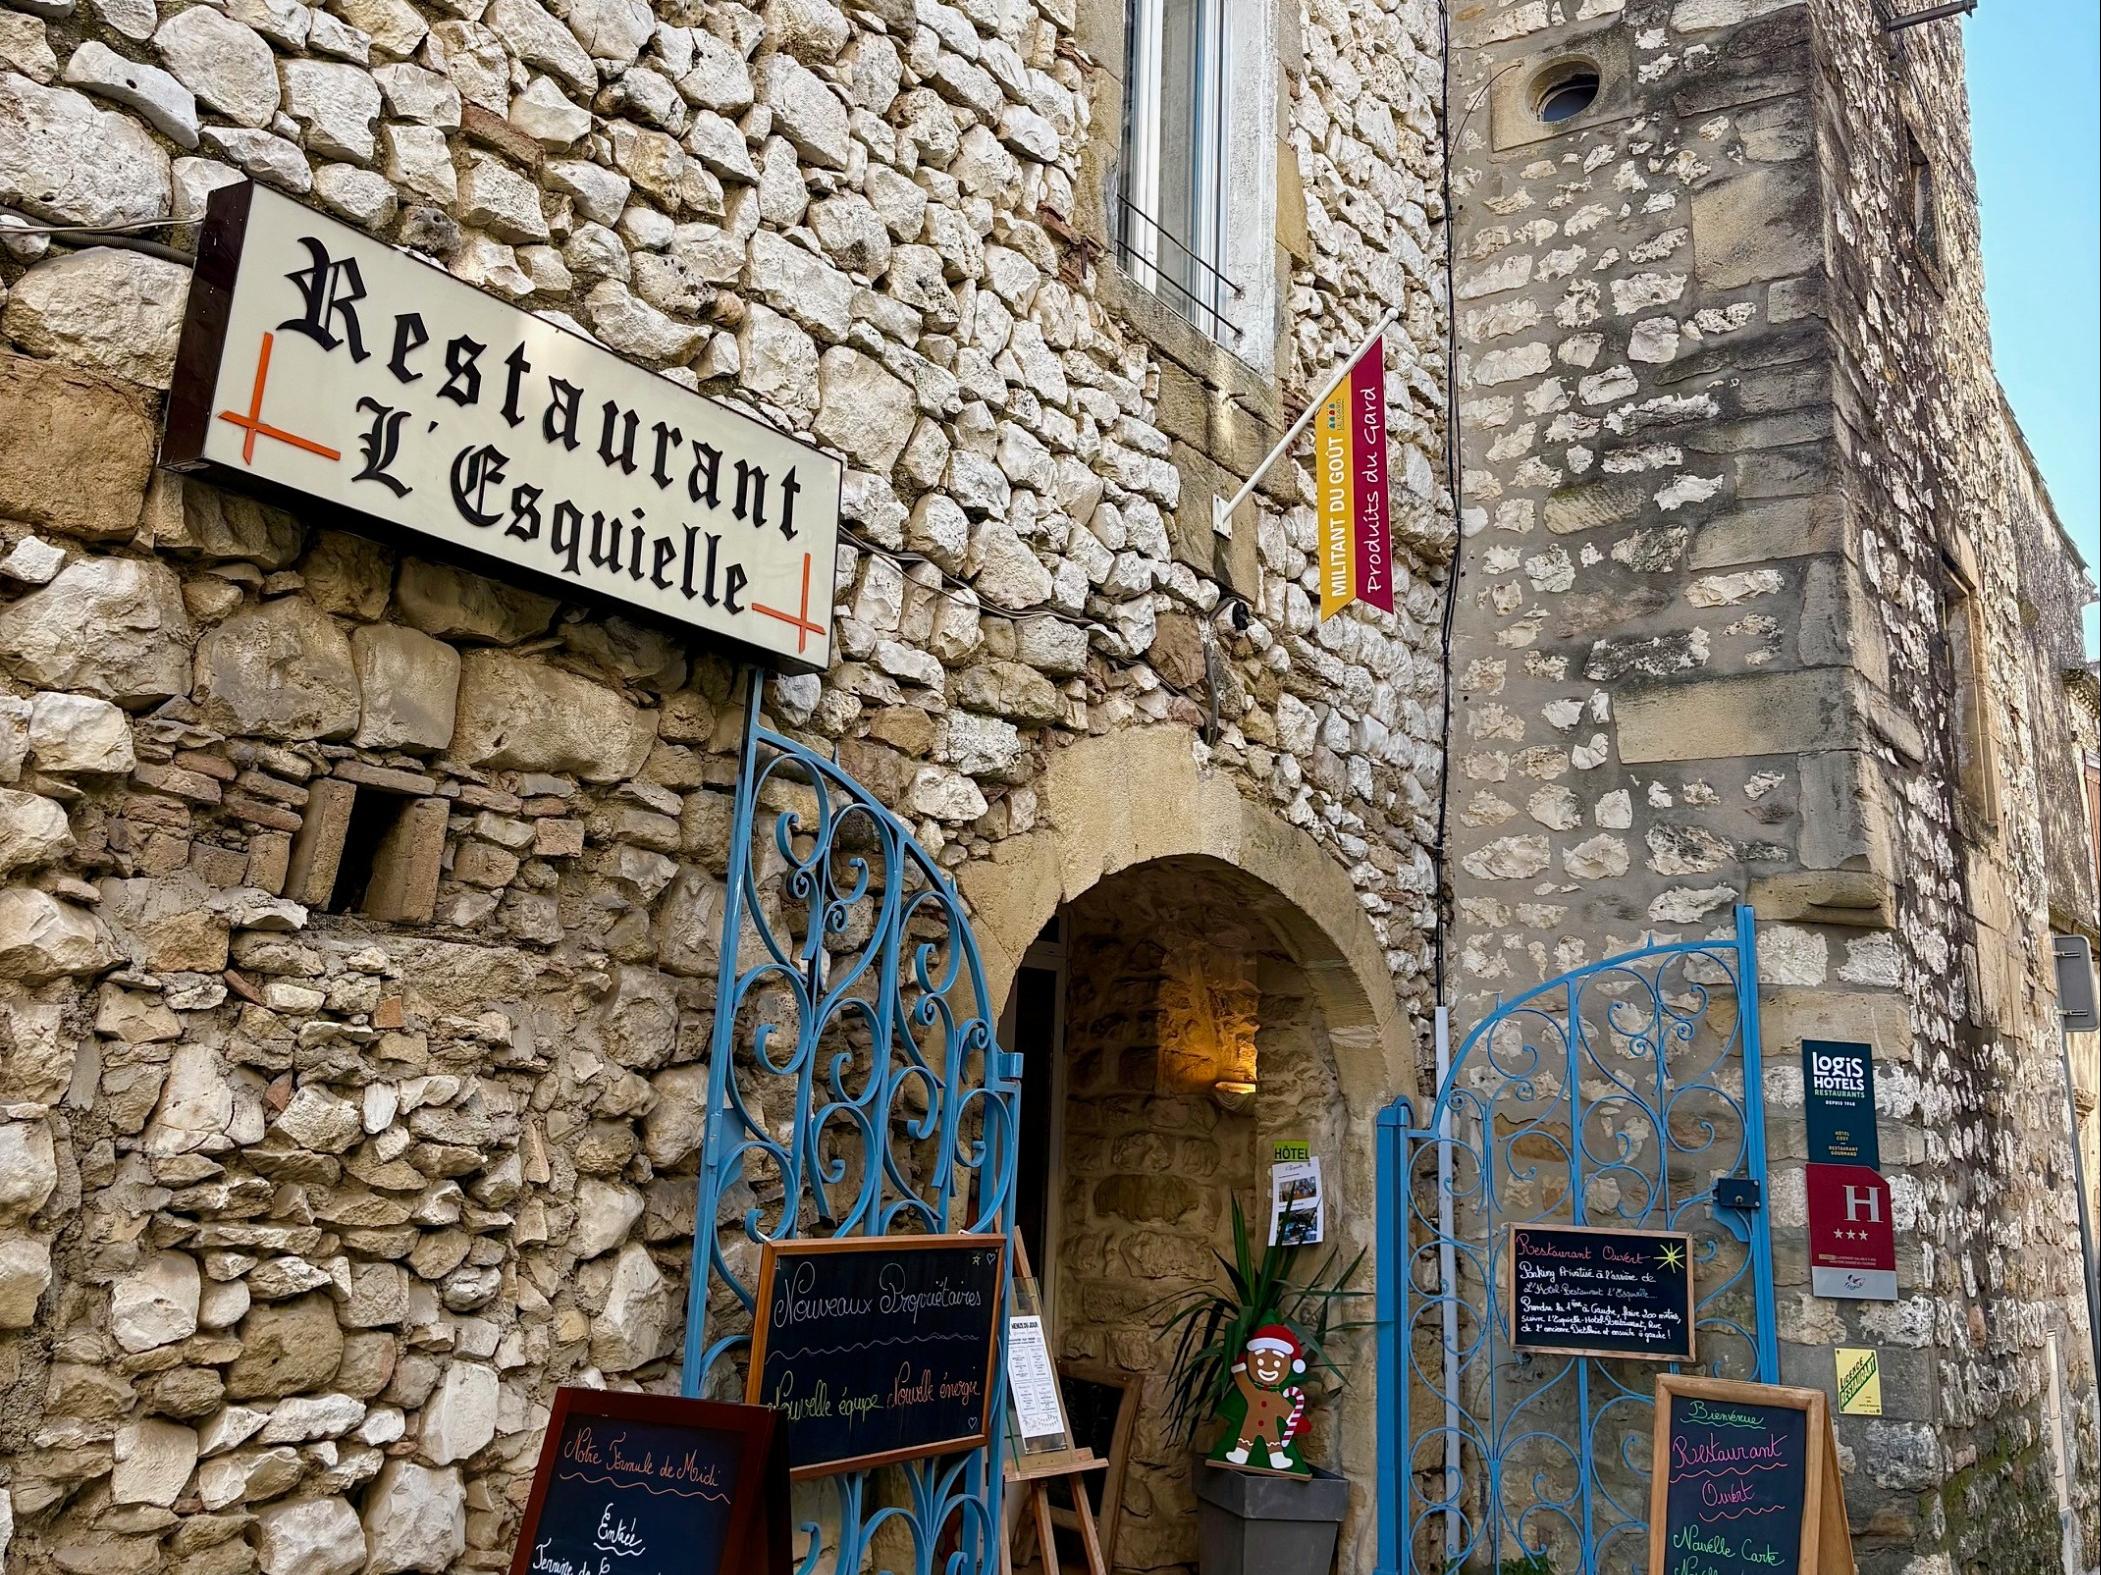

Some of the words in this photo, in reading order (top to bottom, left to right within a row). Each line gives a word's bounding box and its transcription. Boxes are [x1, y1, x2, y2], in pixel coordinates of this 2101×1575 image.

[276, 237, 801, 541] Restaurant
[1361, 386, 1378, 444] Gard
[1327, 436, 1344, 485] GOÛT
[1362, 452, 1378, 483] du
[351, 396, 751, 614] L'Esquielle
[1329, 487, 1345, 513] DU
[1331, 518, 1346, 598] MILITANT
[1361, 490, 1381, 595] Produits
[1814, 1076, 1865, 1091] HOTELS
[1815, 1089, 1865, 1099] RESTAURANTS
[1275, 1145, 1310, 1160] HÔTEL
[1842, 1185, 1883, 1223] H
[1516, 1233, 1592, 1260] Restaurant
[1602, 1245, 1645, 1265] Ouvert
[1519, 1261, 1555, 1283] Parking
[1596, 1270, 1604, 1279] à
[1641, 1272, 1657, 1283] de
[774, 1261, 872, 1328] Nouveaux
[1520, 1295, 1554, 1313] Prendre
[1556, 1302, 1565, 1312] la
[1582, 1304, 1590, 1313] à
[1622, 1305, 1640, 1320] faire
[1641, 1308, 1657, 1319] 200
[1521, 1314, 1546, 1323] suivre
[1521, 1323, 1533, 1332] de
[1602, 1327, 1610, 1336] et
[1611, 1328, 1636, 1337] ensuite
[1840, 1356, 1863, 1390] LICENCE
[839, 1386, 885, 1432] équipe
[886, 1361, 935, 1409] Nouvelle
[1688, 1400, 1764, 1425] Bienvenue
[564, 1427, 602, 1465] Notre
[606, 1432, 654, 1476] Formule
[660, 1456, 675, 1478] de
[676, 1449, 720, 1487] Midi
[1673, 1432, 1788, 1469] Restaurant
[1702, 1479, 1754, 1507] Ouvert
[597, 1503, 643, 1548] Entrée
[1673, 1524, 1736, 1558] Nouvelle
[1741, 1538, 1785, 1567] Carte
